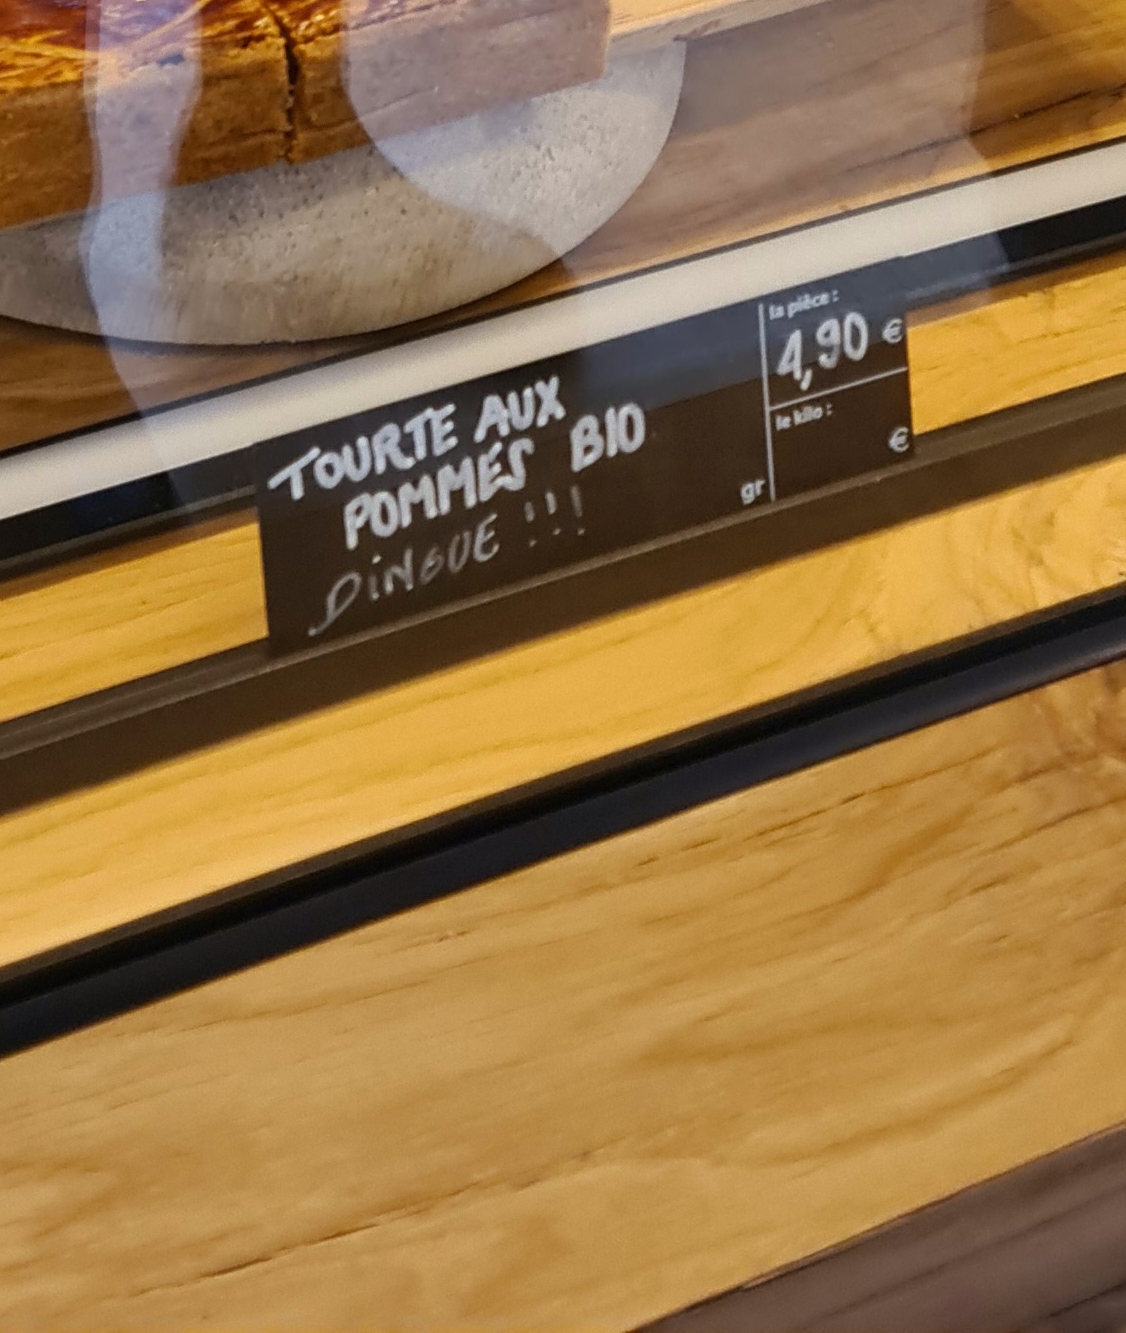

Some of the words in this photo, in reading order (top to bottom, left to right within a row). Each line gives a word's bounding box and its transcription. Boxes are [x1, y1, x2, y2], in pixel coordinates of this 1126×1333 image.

[776, 310, 869, 392] 4,90
[881, 318, 903, 344] €
[267, 403, 459, 501] TOURTE
[475, 375, 566, 443] AUX
[343, 437, 535, 551] POMMES
[570, 402, 646, 472] BIO
[888, 427, 910, 453] €
[740, 479, 766, 505] gr
